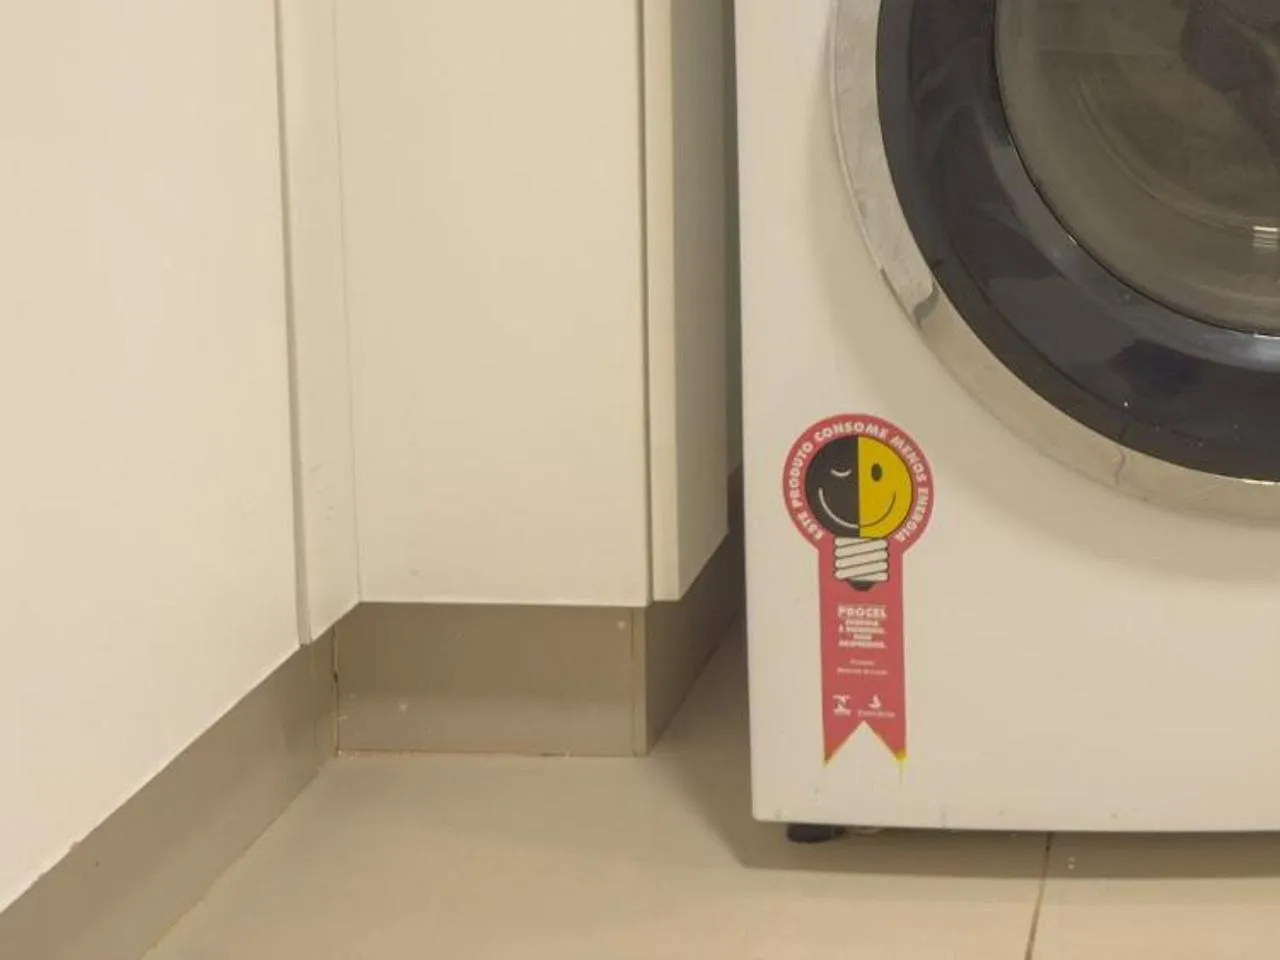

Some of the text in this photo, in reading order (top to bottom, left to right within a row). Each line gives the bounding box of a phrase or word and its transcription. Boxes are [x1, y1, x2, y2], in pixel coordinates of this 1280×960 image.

[788, 421, 930, 542] ESTE PRODUTO CONSOME MENOS ENERGIA
[837, 605, 887, 619] PROCEL
